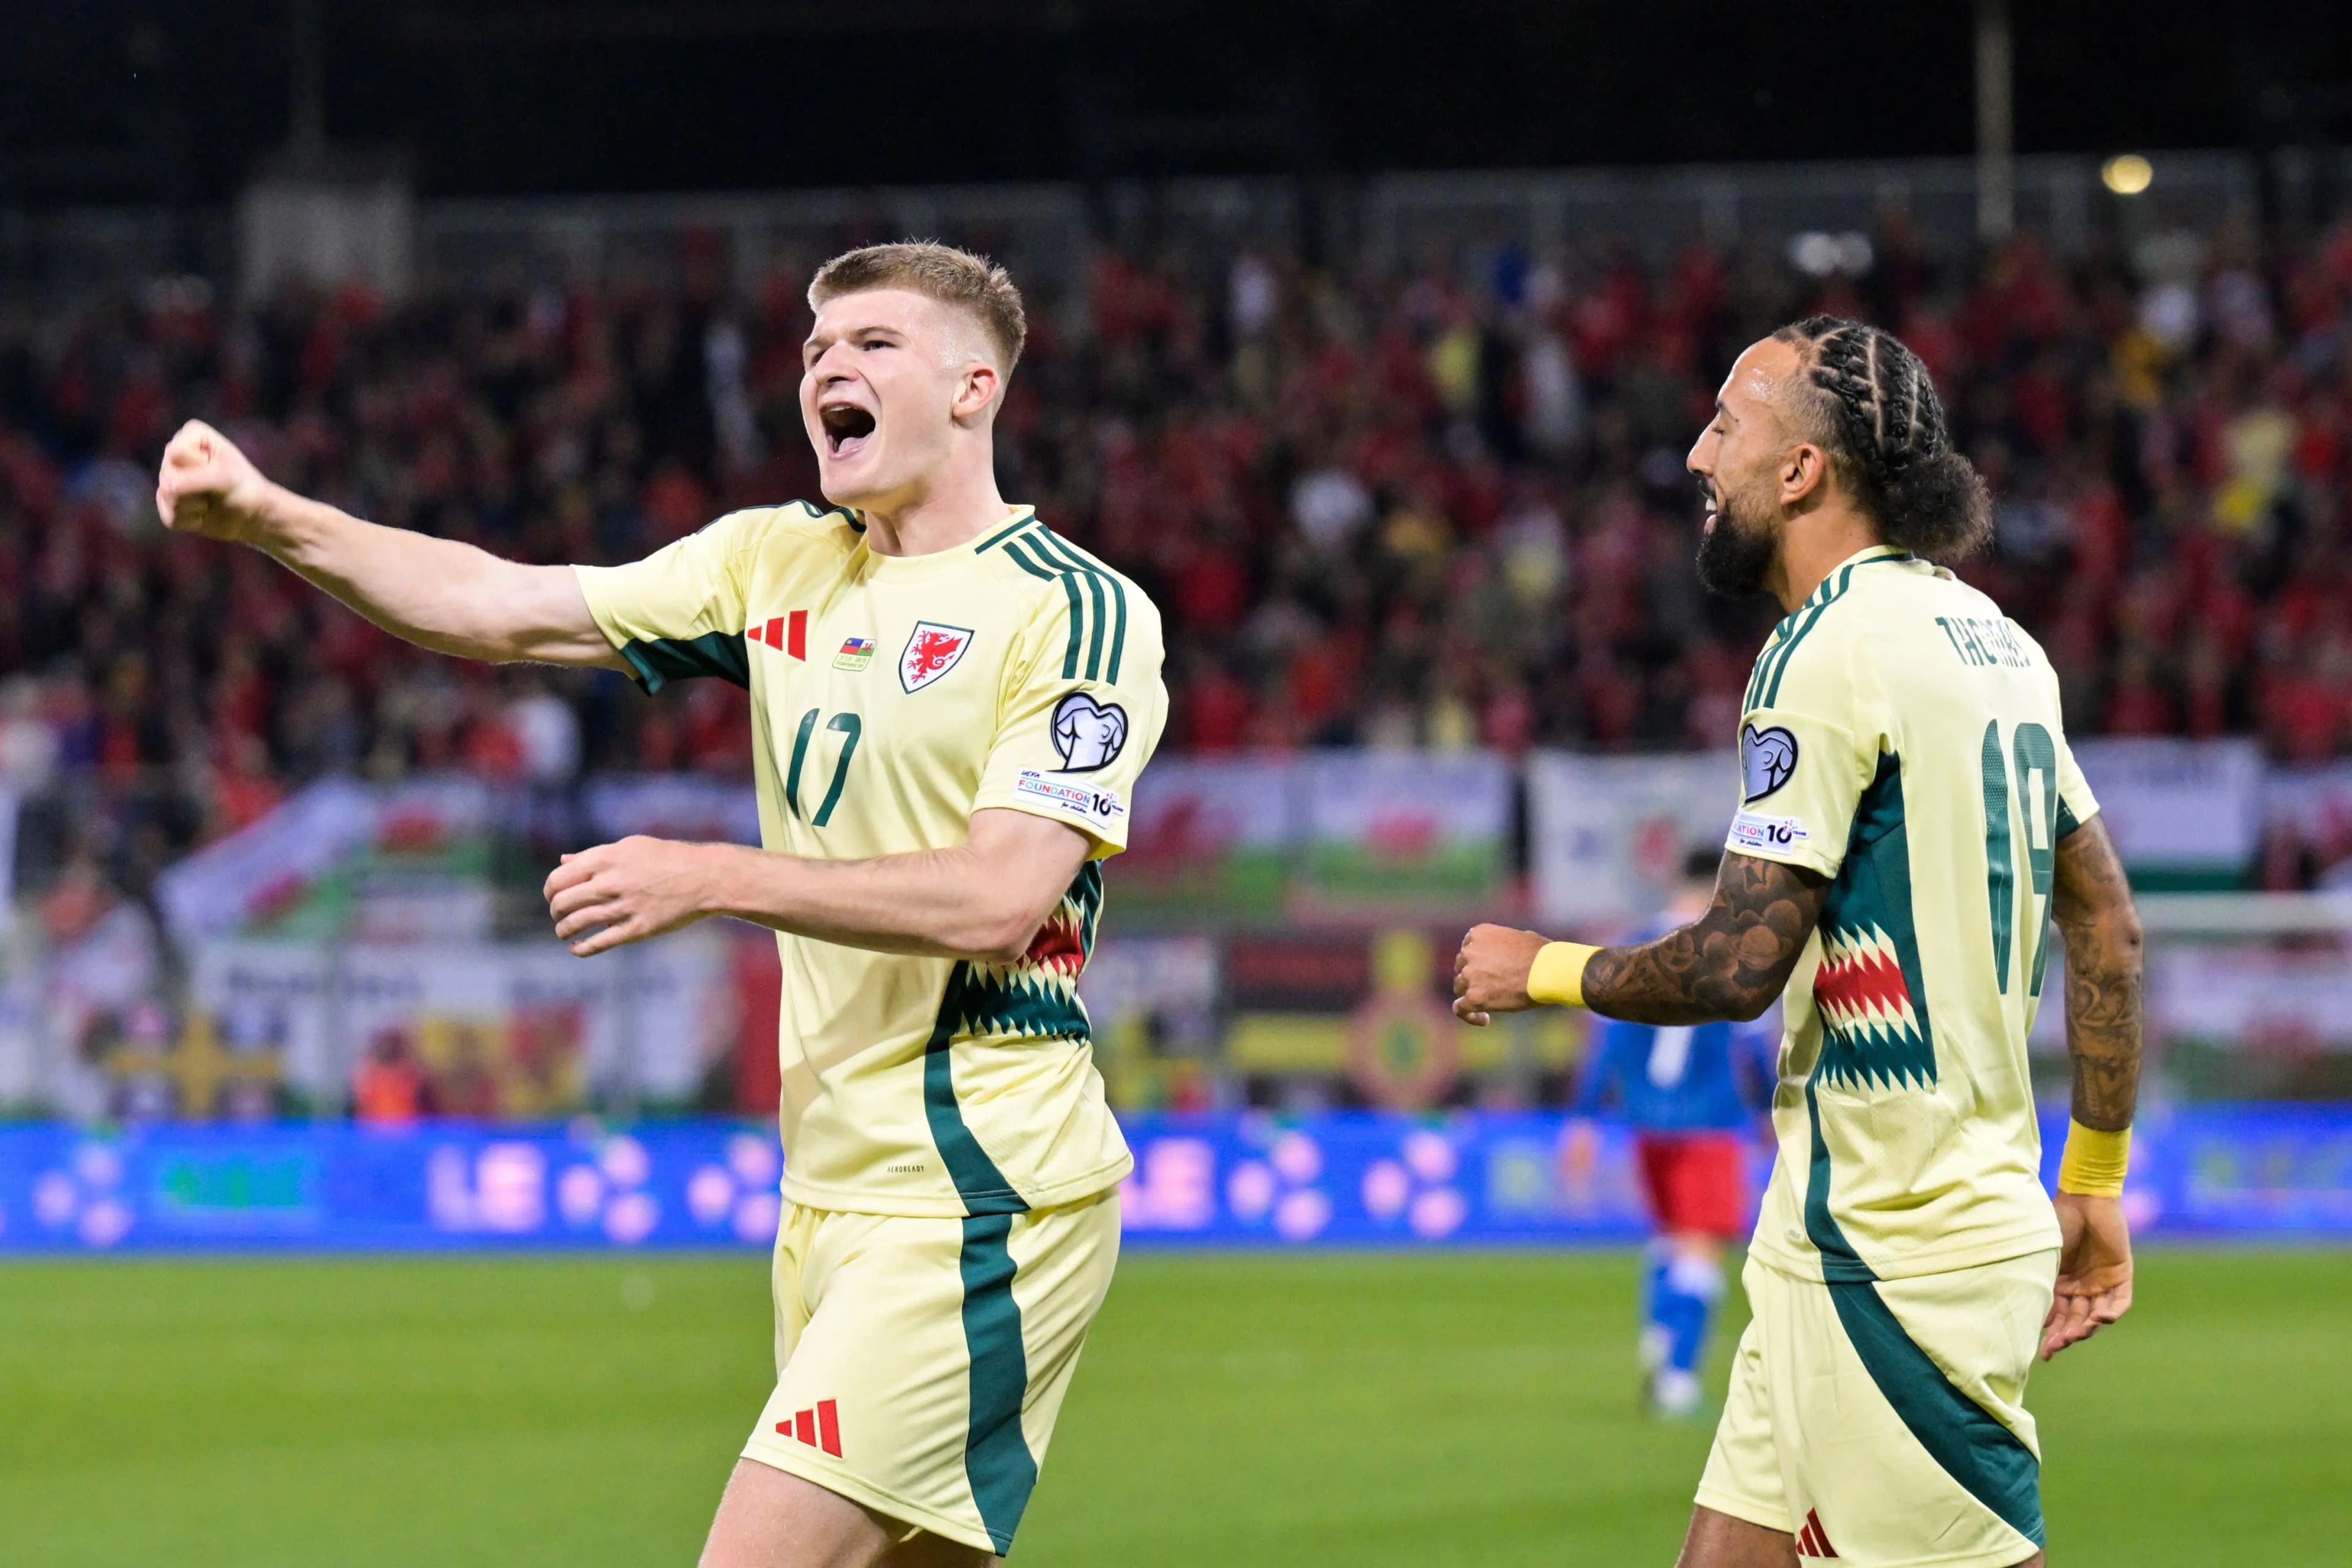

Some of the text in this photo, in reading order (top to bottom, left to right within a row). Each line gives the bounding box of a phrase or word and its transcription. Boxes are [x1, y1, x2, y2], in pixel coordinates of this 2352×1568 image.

[786, 707, 862, 827] 17
[1021, 770, 1040, 778] UEFA
[1018, 779, 1090, 805] FOUNDATION
[1093, 793, 1111, 816] 10
[1736, 824, 1764, 837] ATION
[1767, 824, 1792, 844] 10
[1981, 718, 2056, 997] 19
